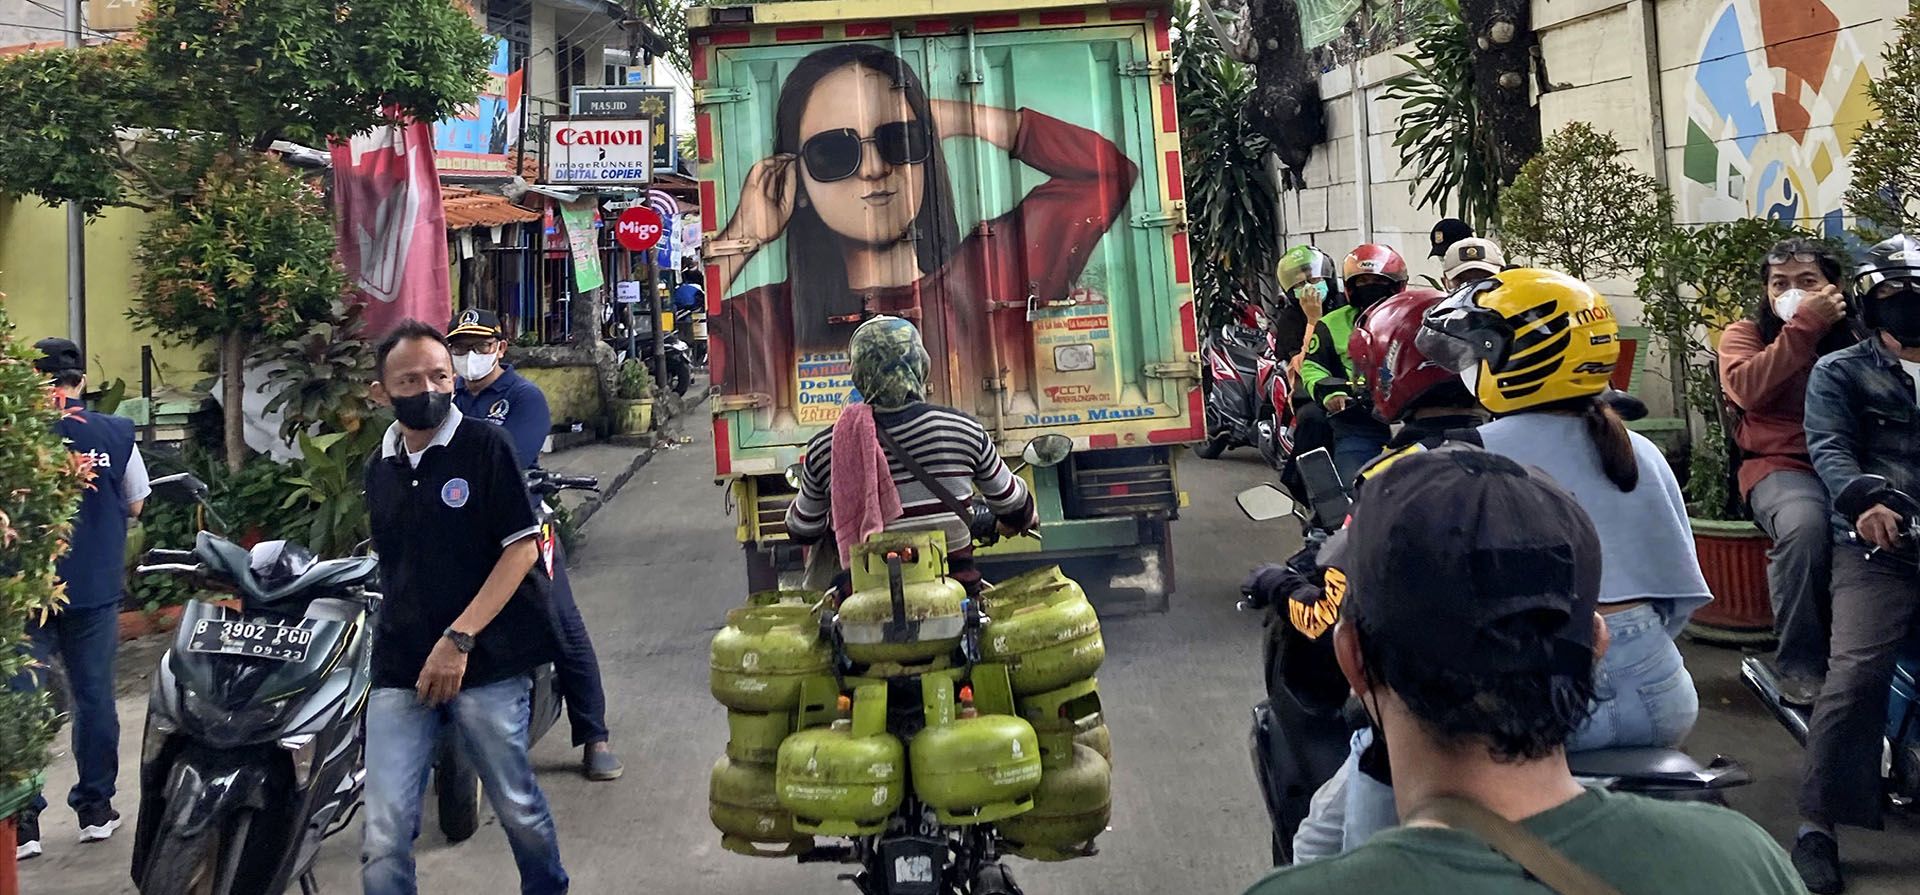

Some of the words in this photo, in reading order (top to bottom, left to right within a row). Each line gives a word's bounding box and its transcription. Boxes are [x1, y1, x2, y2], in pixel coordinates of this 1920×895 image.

[591, 102, 627, 110] MASJID
[556, 128, 642, 146] Canon
[555, 169, 597, 179] DIGITAL
[600, 168, 642, 179] COPIER
[618, 221, 659, 240] Migo
[1060, 385, 1092, 395] CCTV
[799, 392, 843, 405] Orang
[1024, 413, 1081, 426] Nona
[1088, 406, 1155, 421] Manis
[196, 621, 208, 634] B
[222, 622, 266, 640] 3902
[277, 628, 310, 645] PGD
